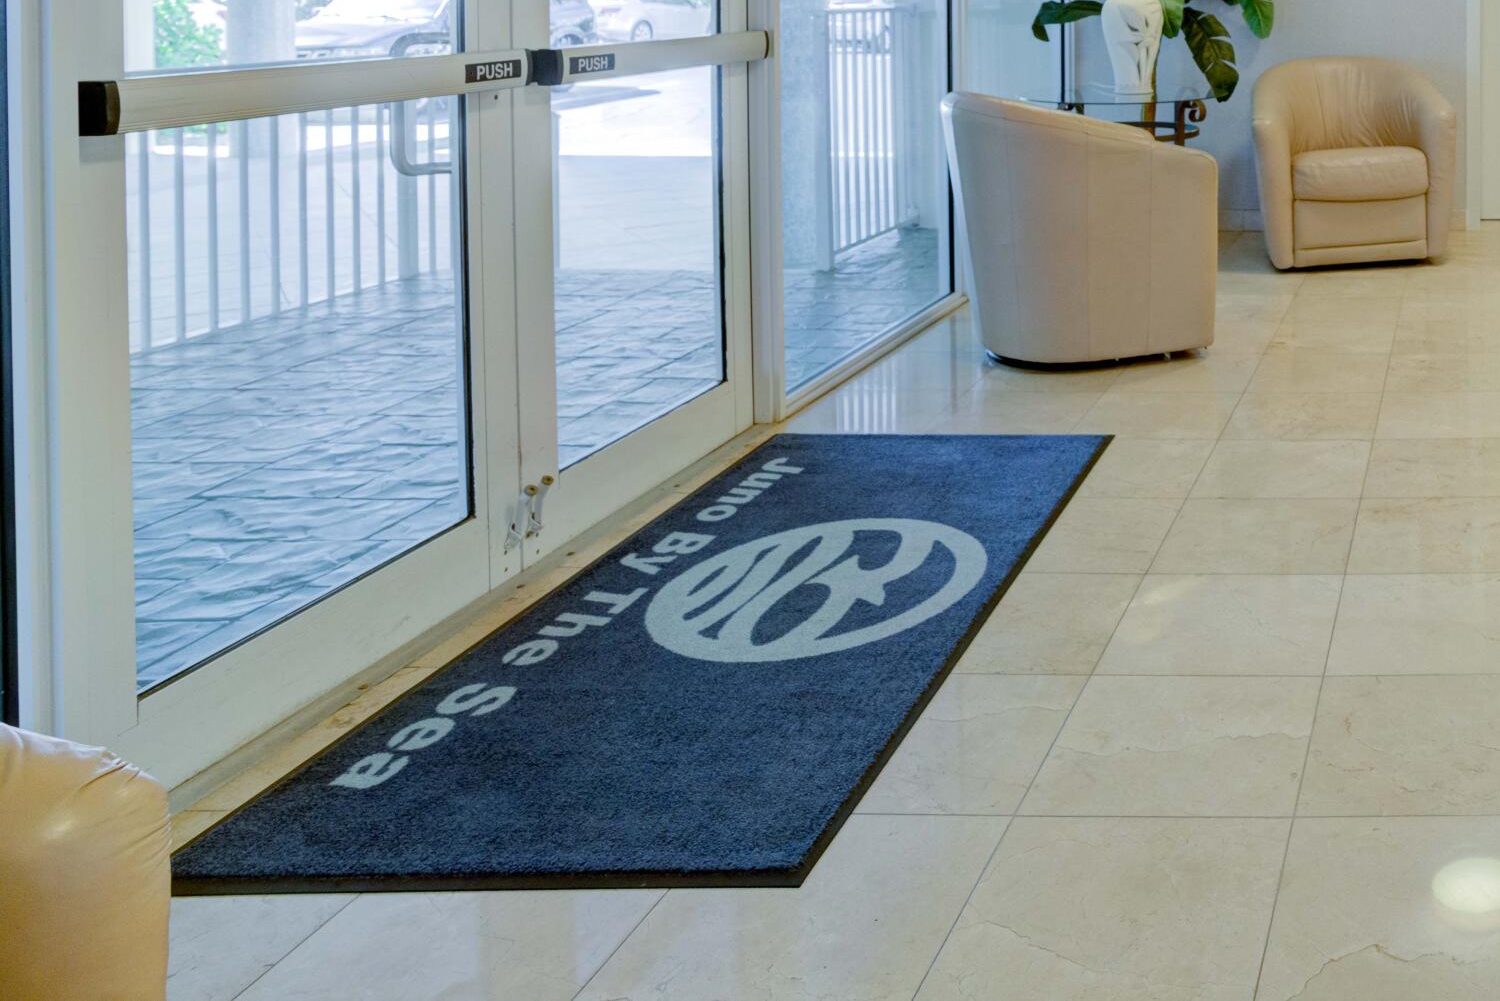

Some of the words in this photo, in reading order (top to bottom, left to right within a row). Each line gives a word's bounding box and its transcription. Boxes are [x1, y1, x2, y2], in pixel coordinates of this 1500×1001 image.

[476, 62, 513, 81] PUSH
[577, 56, 609, 72] PUSH
[696, 457, 804, 522] Juno
[619, 531, 717, 575] By
[502, 587, 648, 666] The
[327, 683, 518, 790] Sea
